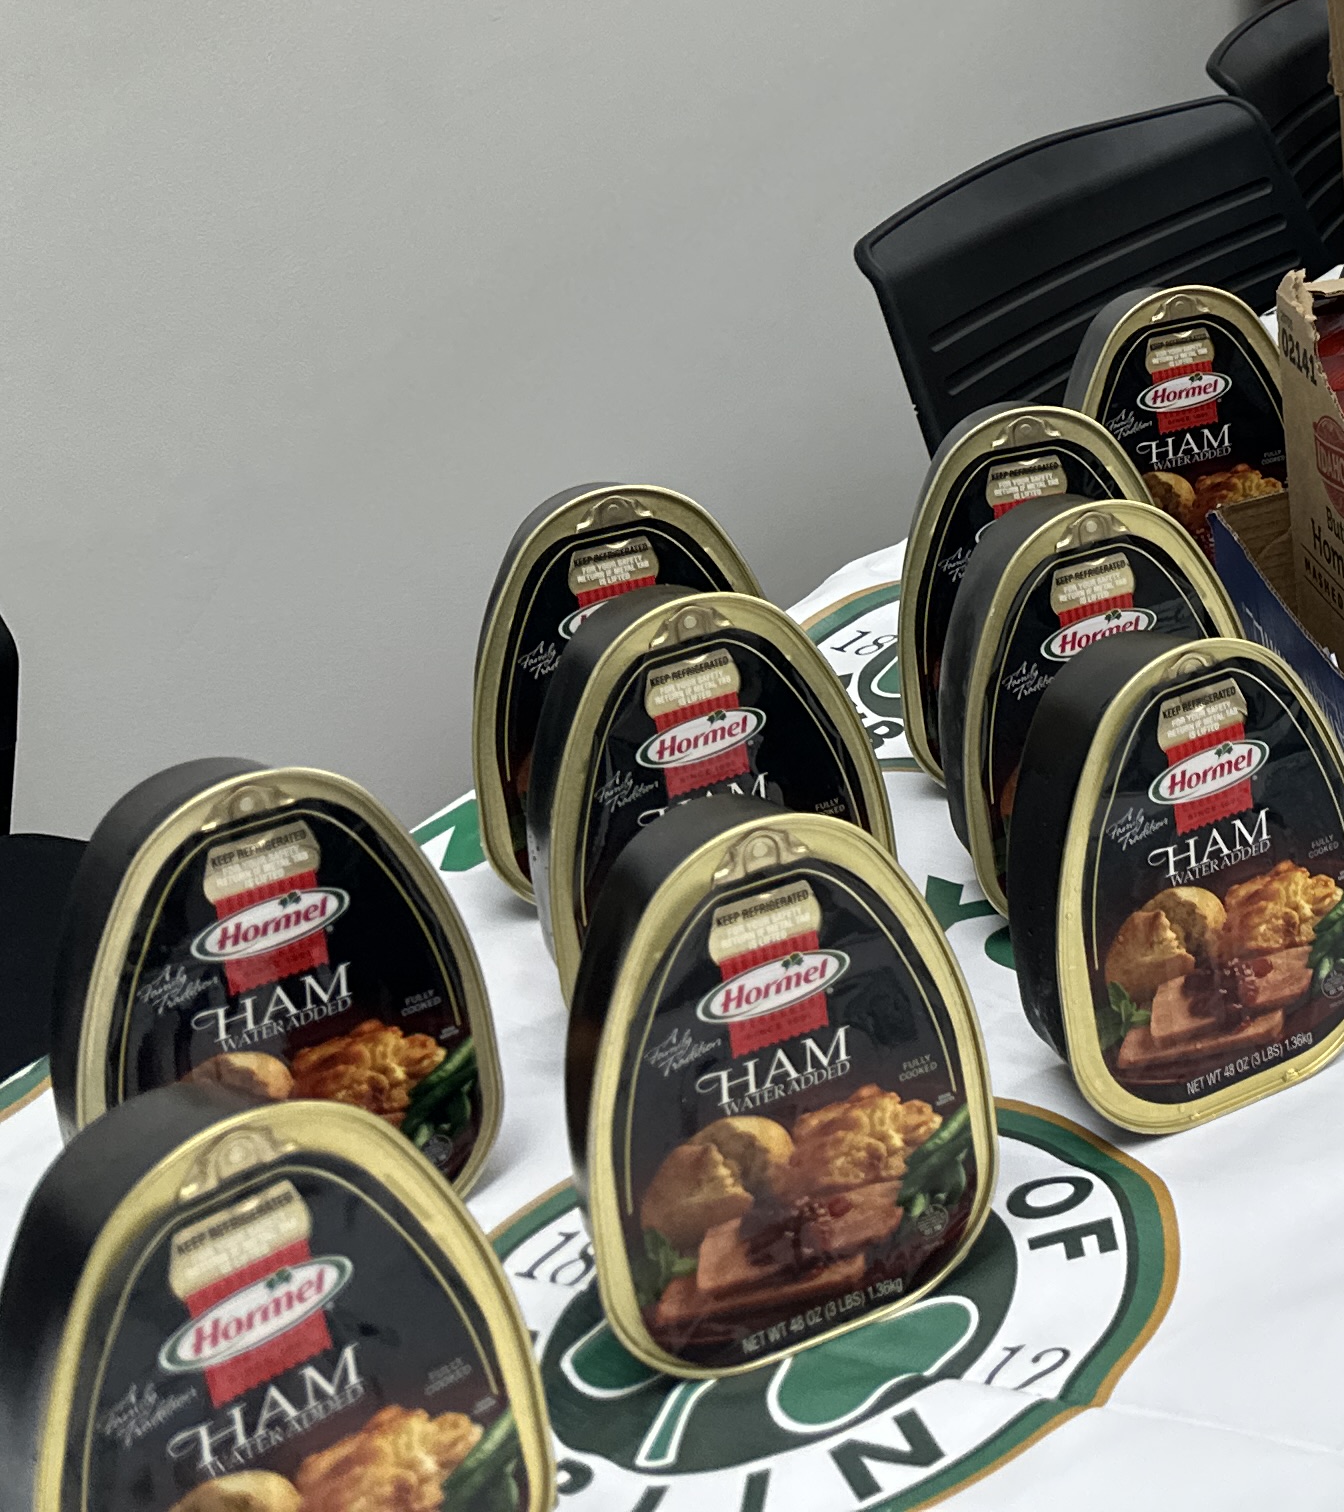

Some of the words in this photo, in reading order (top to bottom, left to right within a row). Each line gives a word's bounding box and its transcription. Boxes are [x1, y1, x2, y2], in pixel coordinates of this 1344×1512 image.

[1282, 326, 1318, 386] 02141
[1151, 379, 1219, 405] Hormel
[1136, 423, 1232, 464] HAM
[1153, 454, 1192, 472] WATER
[1191, 445, 1232, 464] ADDED
[1304, 560, 1344, 610] MASHED
[1163, 705, 1180, 719] KEEP
[1181, 688, 1237, 714] REFRIGERATED
[657, 712, 749, 761] Hormel
[1168, 750, 1253, 797] Hormel
[814, 797, 840, 812] FULLY
[1148, 807, 1271, 878] HAM
[1170, 859, 1223, 887] WATER
[1221, 840, 1271, 869] ADDED
[217, 895, 329, 952] Hormel
[716, 912, 743, 928] KEEP
[745, 890, 810, 920] REFRIGERATED
[191, 961, 352, 1042] HAM
[721, 959, 828, 1014] Hormel
[219, 1020, 287, 1054] WATER
[286, 996, 353, 1031] ADDED
[696, 1024, 851, 1106] HAM
[899, 1061, 938, 1083] COOKED
[902, 1054, 933, 1072] FULLY
[1186, 1078, 1205, 1094] NET
[1205, 1070, 1222, 1086] WT
[1223, 1065, 1235, 1077] 48
[1235, 1060, 1250, 1072] OZ
[1251, 1055, 1261, 1068] (3
[1262, 1044, 1284, 1064] LBS)
[1285, 1031, 1313, 1051] 1.36kg
[722, 1089, 789, 1116] WATER
[787, 1067, 851, 1100] ADDED
[1007, 1174, 1121, 1262] OF
[193, 1269, 325, 1359] Hormel
[166, 1342, 366, 1471] HAM
